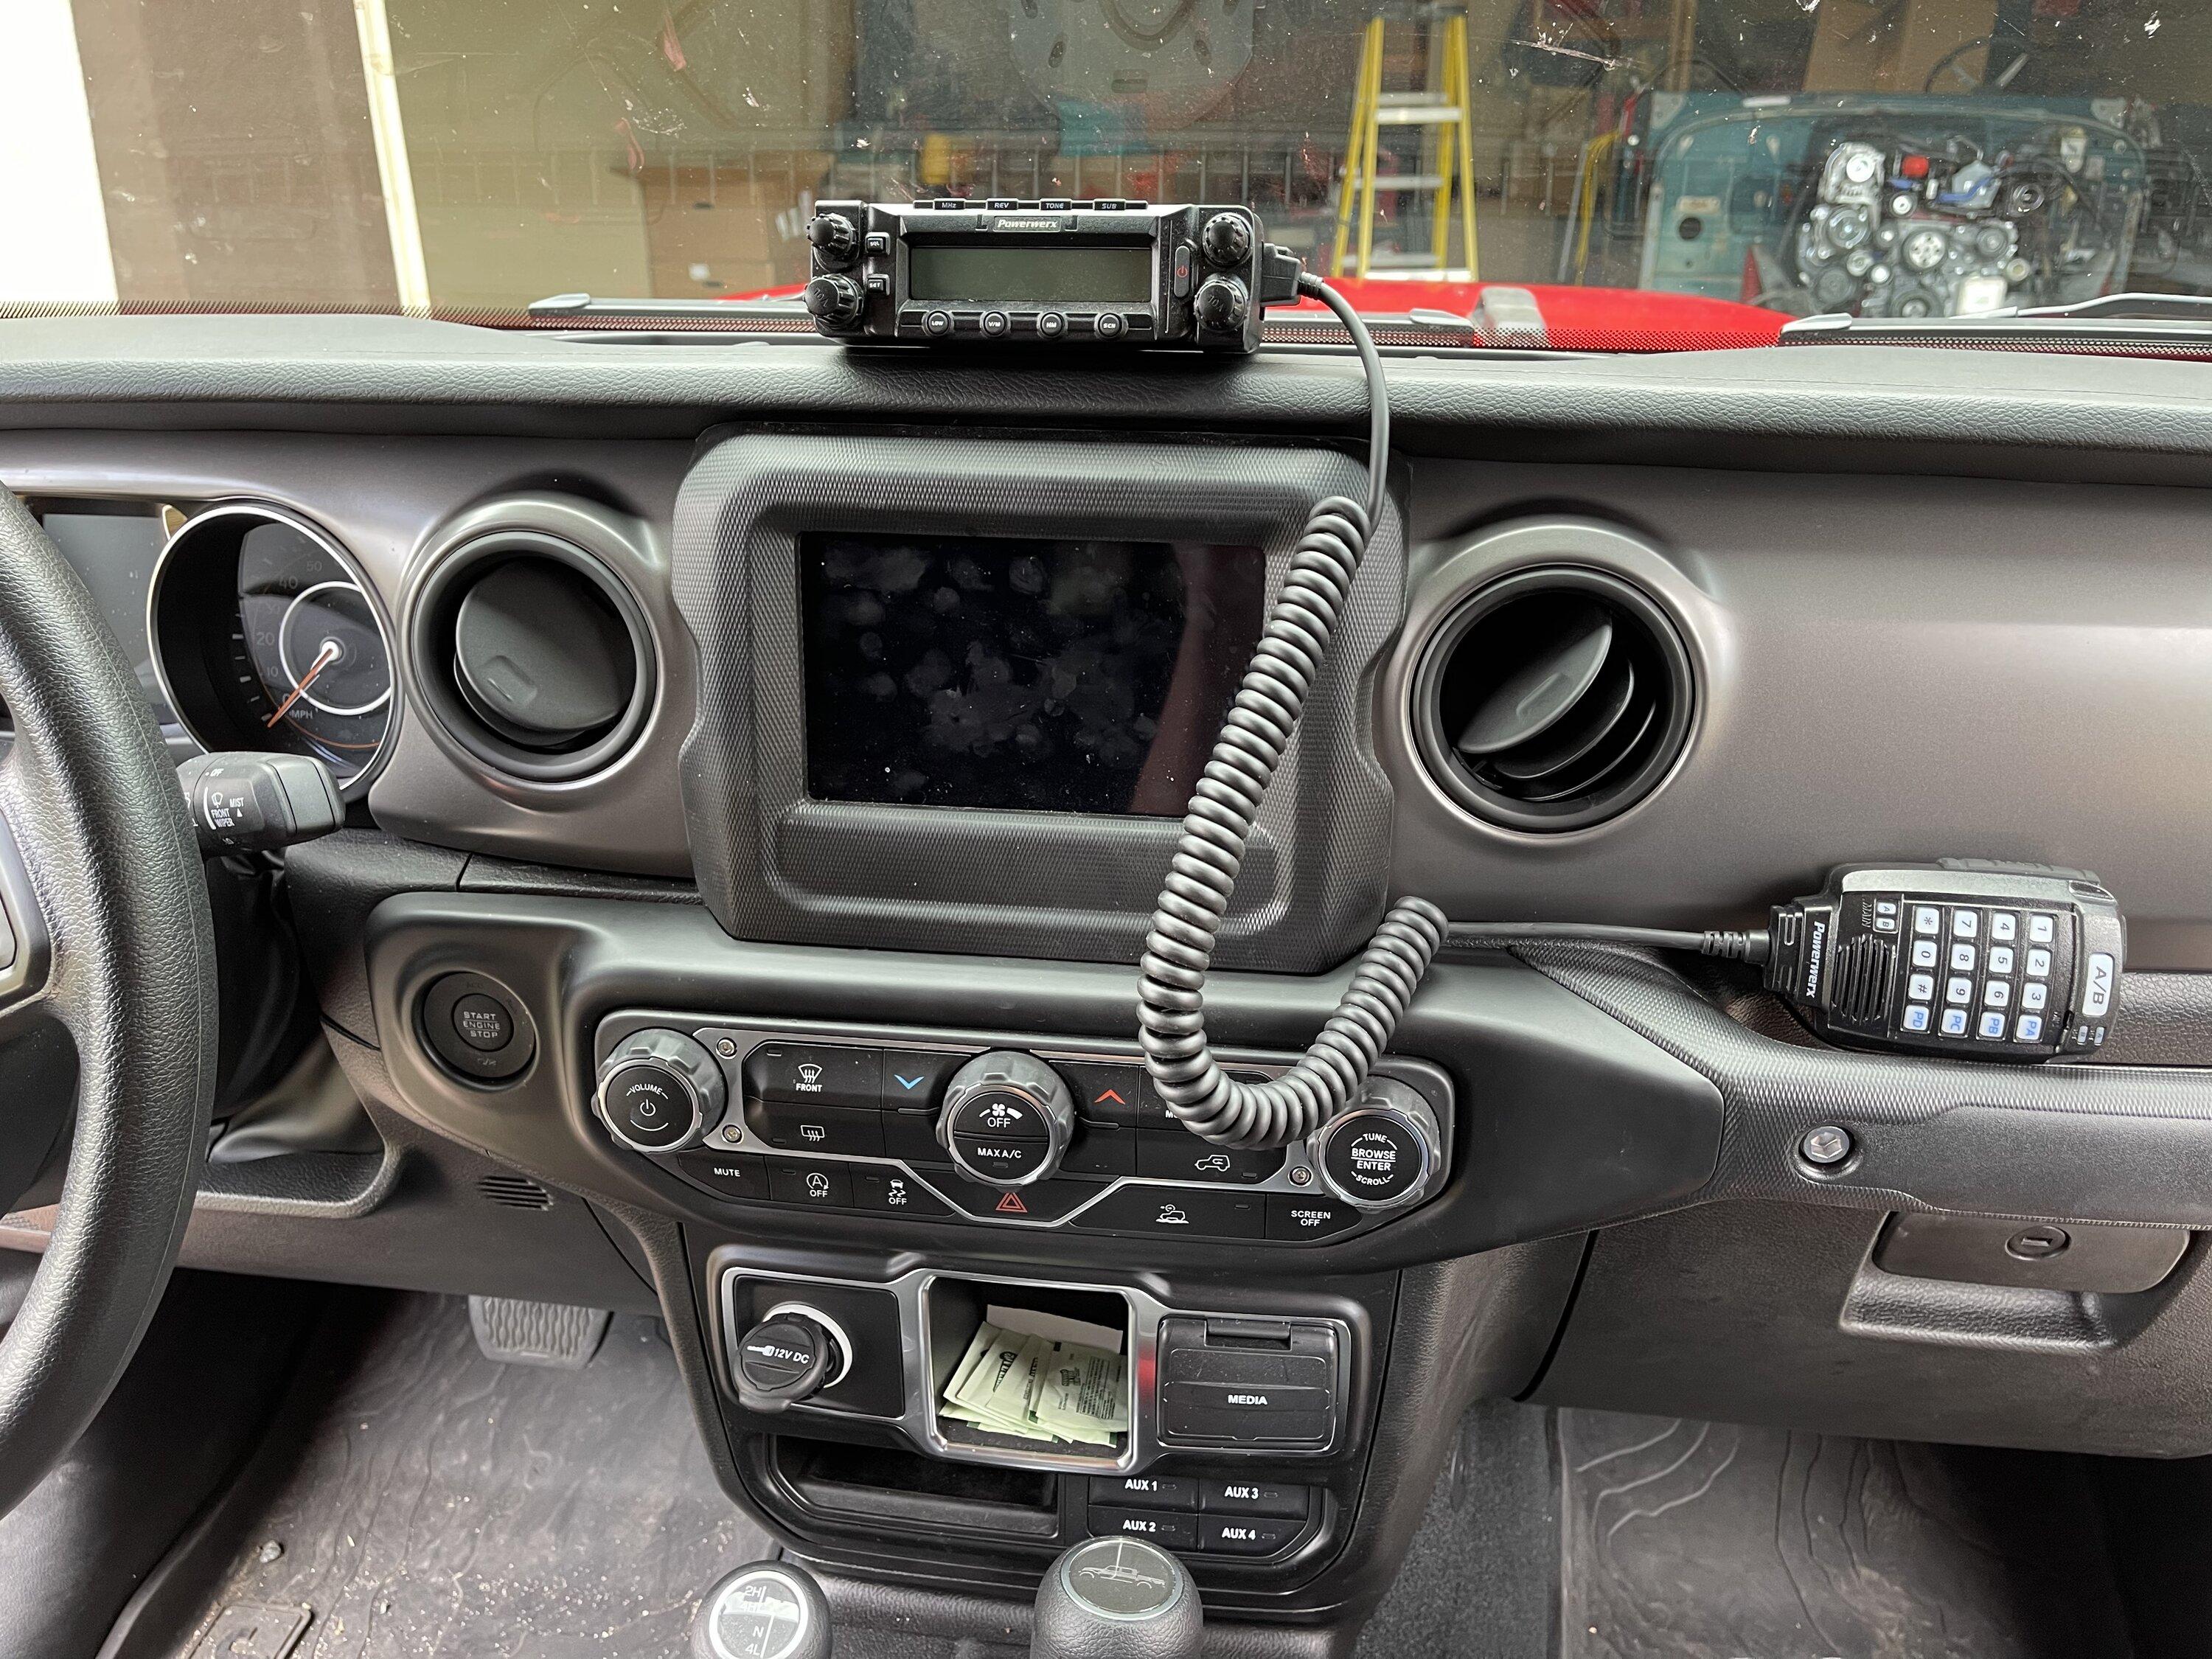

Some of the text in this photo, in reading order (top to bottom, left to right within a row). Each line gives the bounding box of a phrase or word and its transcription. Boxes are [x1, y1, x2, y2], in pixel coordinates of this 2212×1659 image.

[997, 219, 1058, 229] Powerwerx
[257, 632, 275, 646] 20
[291, 709, 313, 720] MPH
[229, 797, 244, 808] MIST
[211, 808, 230, 818] FRONT
[1962, 919, 1972, 928] 7
[2000, 922, 2010, 931] 4
[1806, 921, 1826, 998] Powerwerx
[1959, 953, 1969, 962] 8
[1997, 956, 2008, 964] 5
[2035, 959, 2045, 967] 2
[2093, 966, 2107, 1004] A/B
[1956, 988, 1966, 996] 9
[1994, 990, 2004, 999] 6
[2031, 992, 2041, 1001] 3
[463, 1011, 496, 1020] START
[1913, 1011, 1924, 1028] PD
[462, 1020, 500, 1030] ENGINE
[1950, 1015, 1961, 1031] PC
[1989, 1018, 2000, 1034] PB
[2025, 1020, 2037, 1036] PA
[629, 1083, 663, 1095] VOLUME
[796, 1083, 822, 1093] FRONT
[987, 1116, 1011, 1129] OFF
[1363, 1133, 1387, 1143] TUNE
[977, 1147, 1022, 1160] MAX A/C
[1352, 1147, 1396, 1160] BROWSE
[1357, 1160, 1391, 1171] ENTER
[714, 1167, 740, 1178] MUTE
[1356, 1175, 1390, 1185] SCROLL
[809, 1189, 828, 1197] OFF
[888, 1196, 908, 1206] OFF
[1290, 1209, 1331, 1220] SCREEN
[1300, 1217, 1321, 1227] OFF
[774, 1348, 810, 1364] 12V DC
[1228, 1394, 1267, 1405] MEDIA
[1124, 1479, 1158, 1492] AUX 1
[1224, 1486, 1259, 1499] AUX 3
[1122, 1520, 1156, 1532] AUX 2
[1221, 1527, 1256, 1540] AUX 4
[745, 1585, 762, 1598] 2H
[752, 1626, 764, 1638] N
[745, 1643, 760, 1656] 4L
